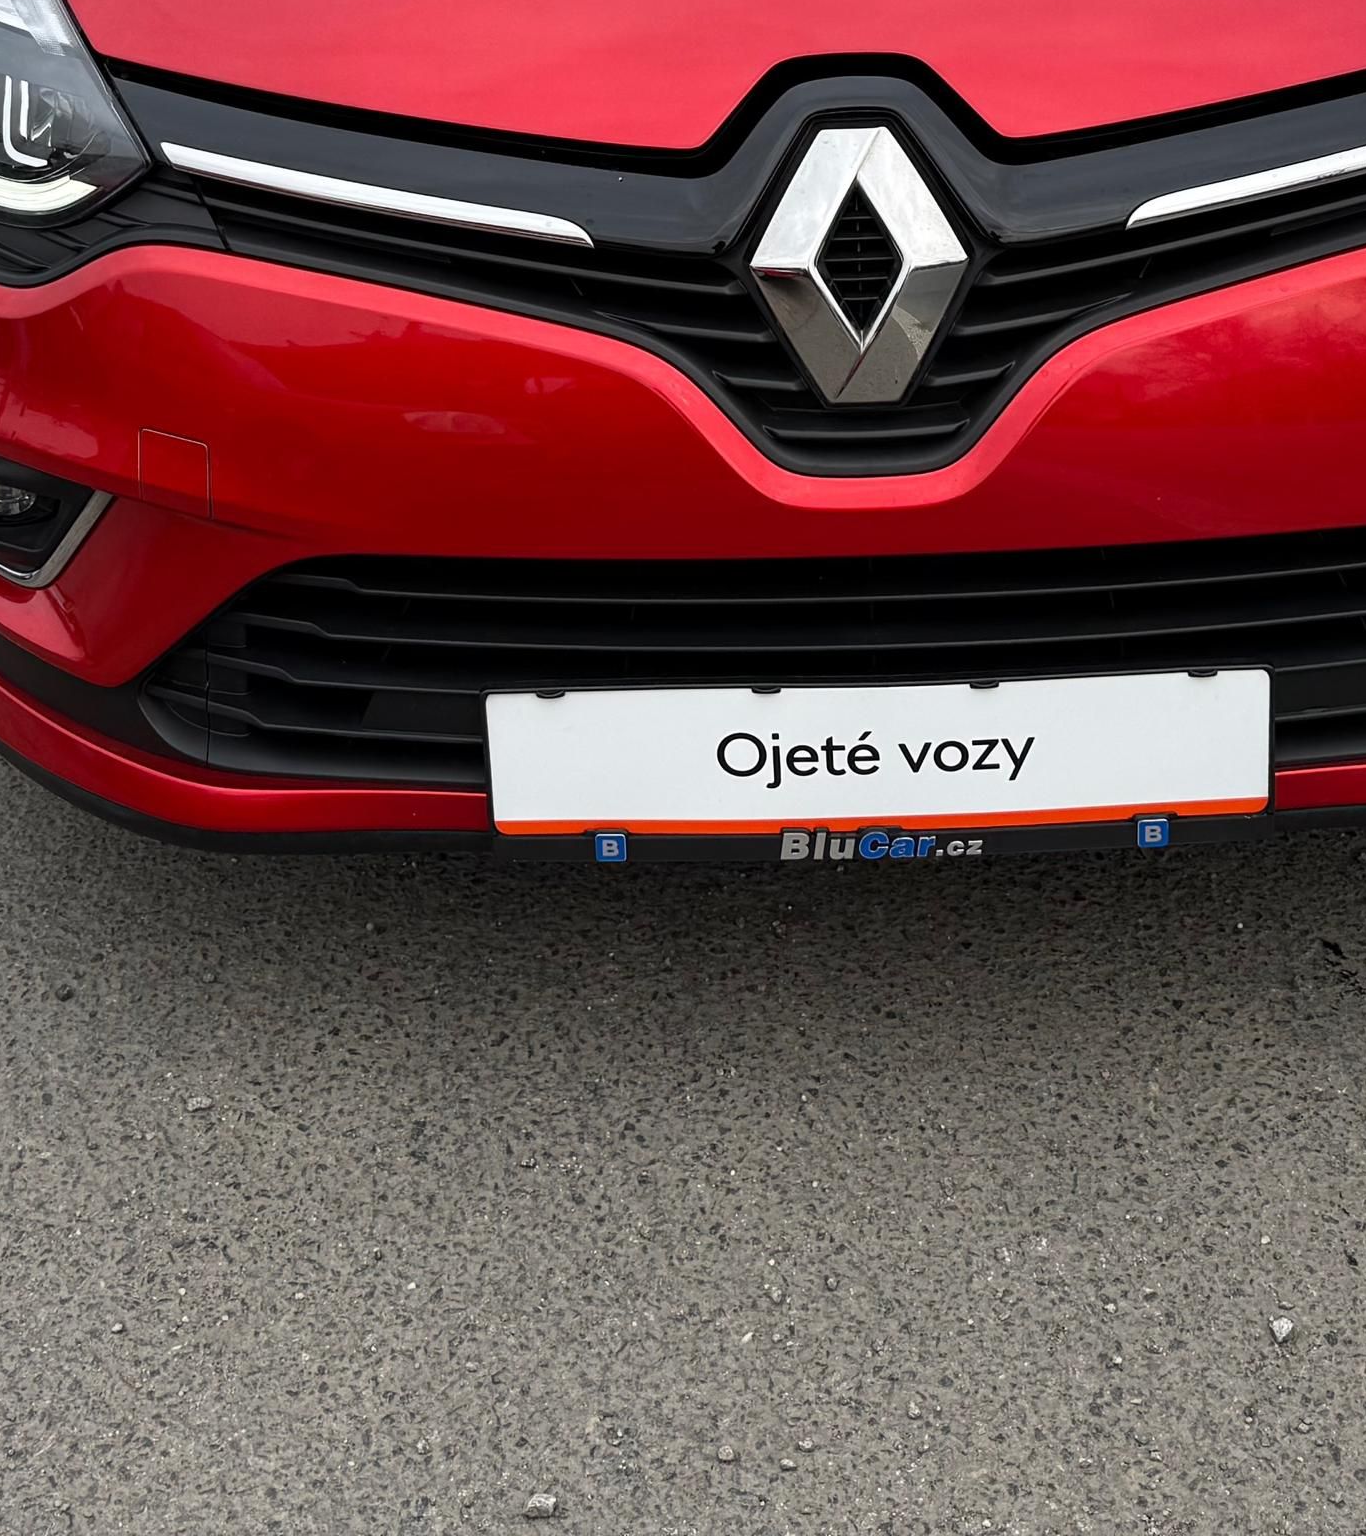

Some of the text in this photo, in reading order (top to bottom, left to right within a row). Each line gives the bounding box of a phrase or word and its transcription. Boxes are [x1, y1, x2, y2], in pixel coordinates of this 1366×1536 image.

[716, 731, 1035, 789] Ojeté vozy
[780, 830, 983, 860] BluCar.cz
[1145, 825, 1162, 842] B
[602, 839, 619, 857] B
